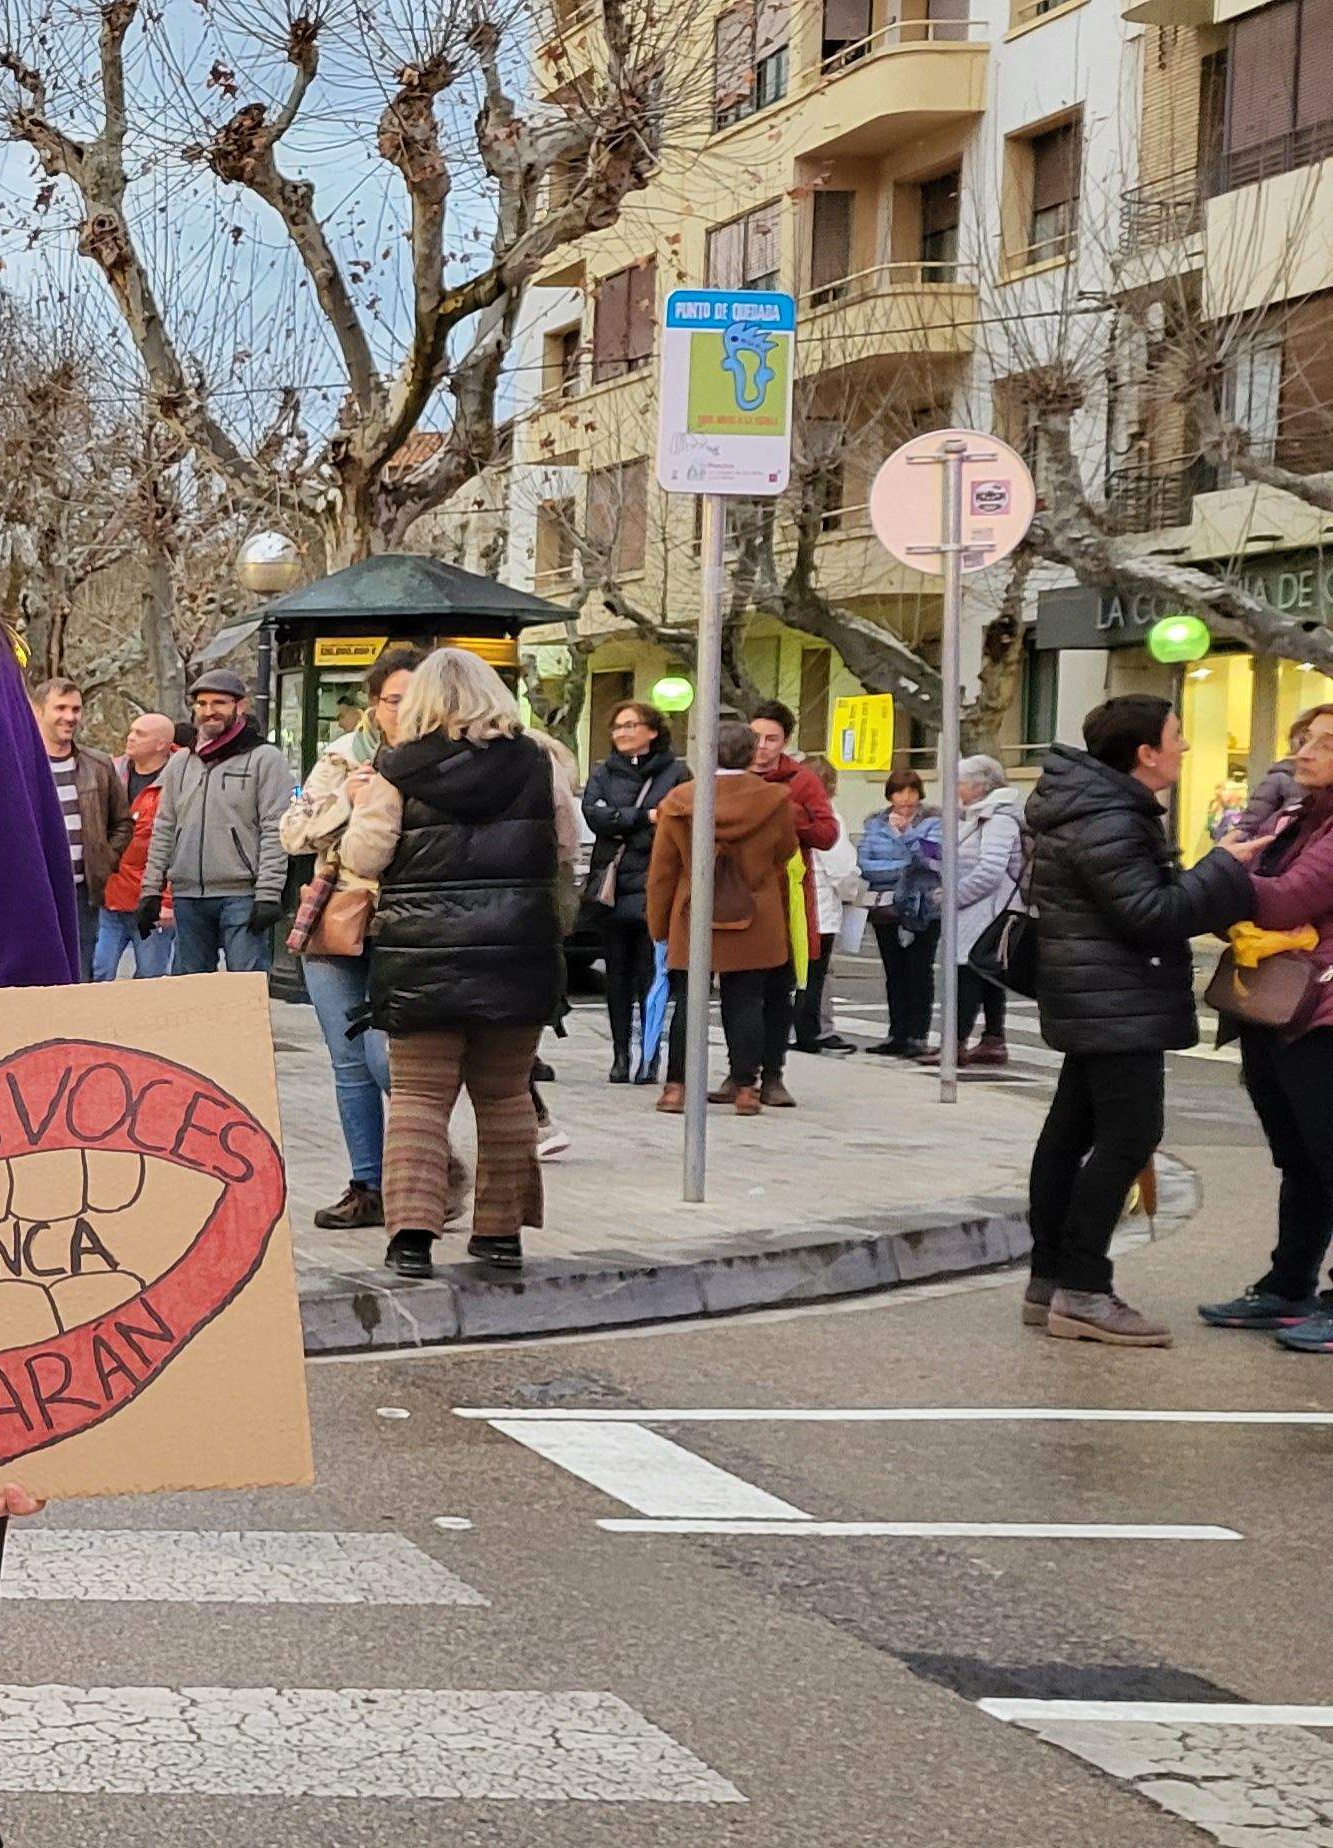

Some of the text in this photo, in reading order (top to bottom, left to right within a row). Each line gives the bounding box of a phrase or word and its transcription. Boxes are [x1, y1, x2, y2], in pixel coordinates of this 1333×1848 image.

[674, 301, 711, 320] PUNTO
[714, 302, 728, 320] DE
[1095, 597, 1124, 629] LA
[1278, 570, 1313, 609] DE
[6, 1061, 259, 1184] VOCES
